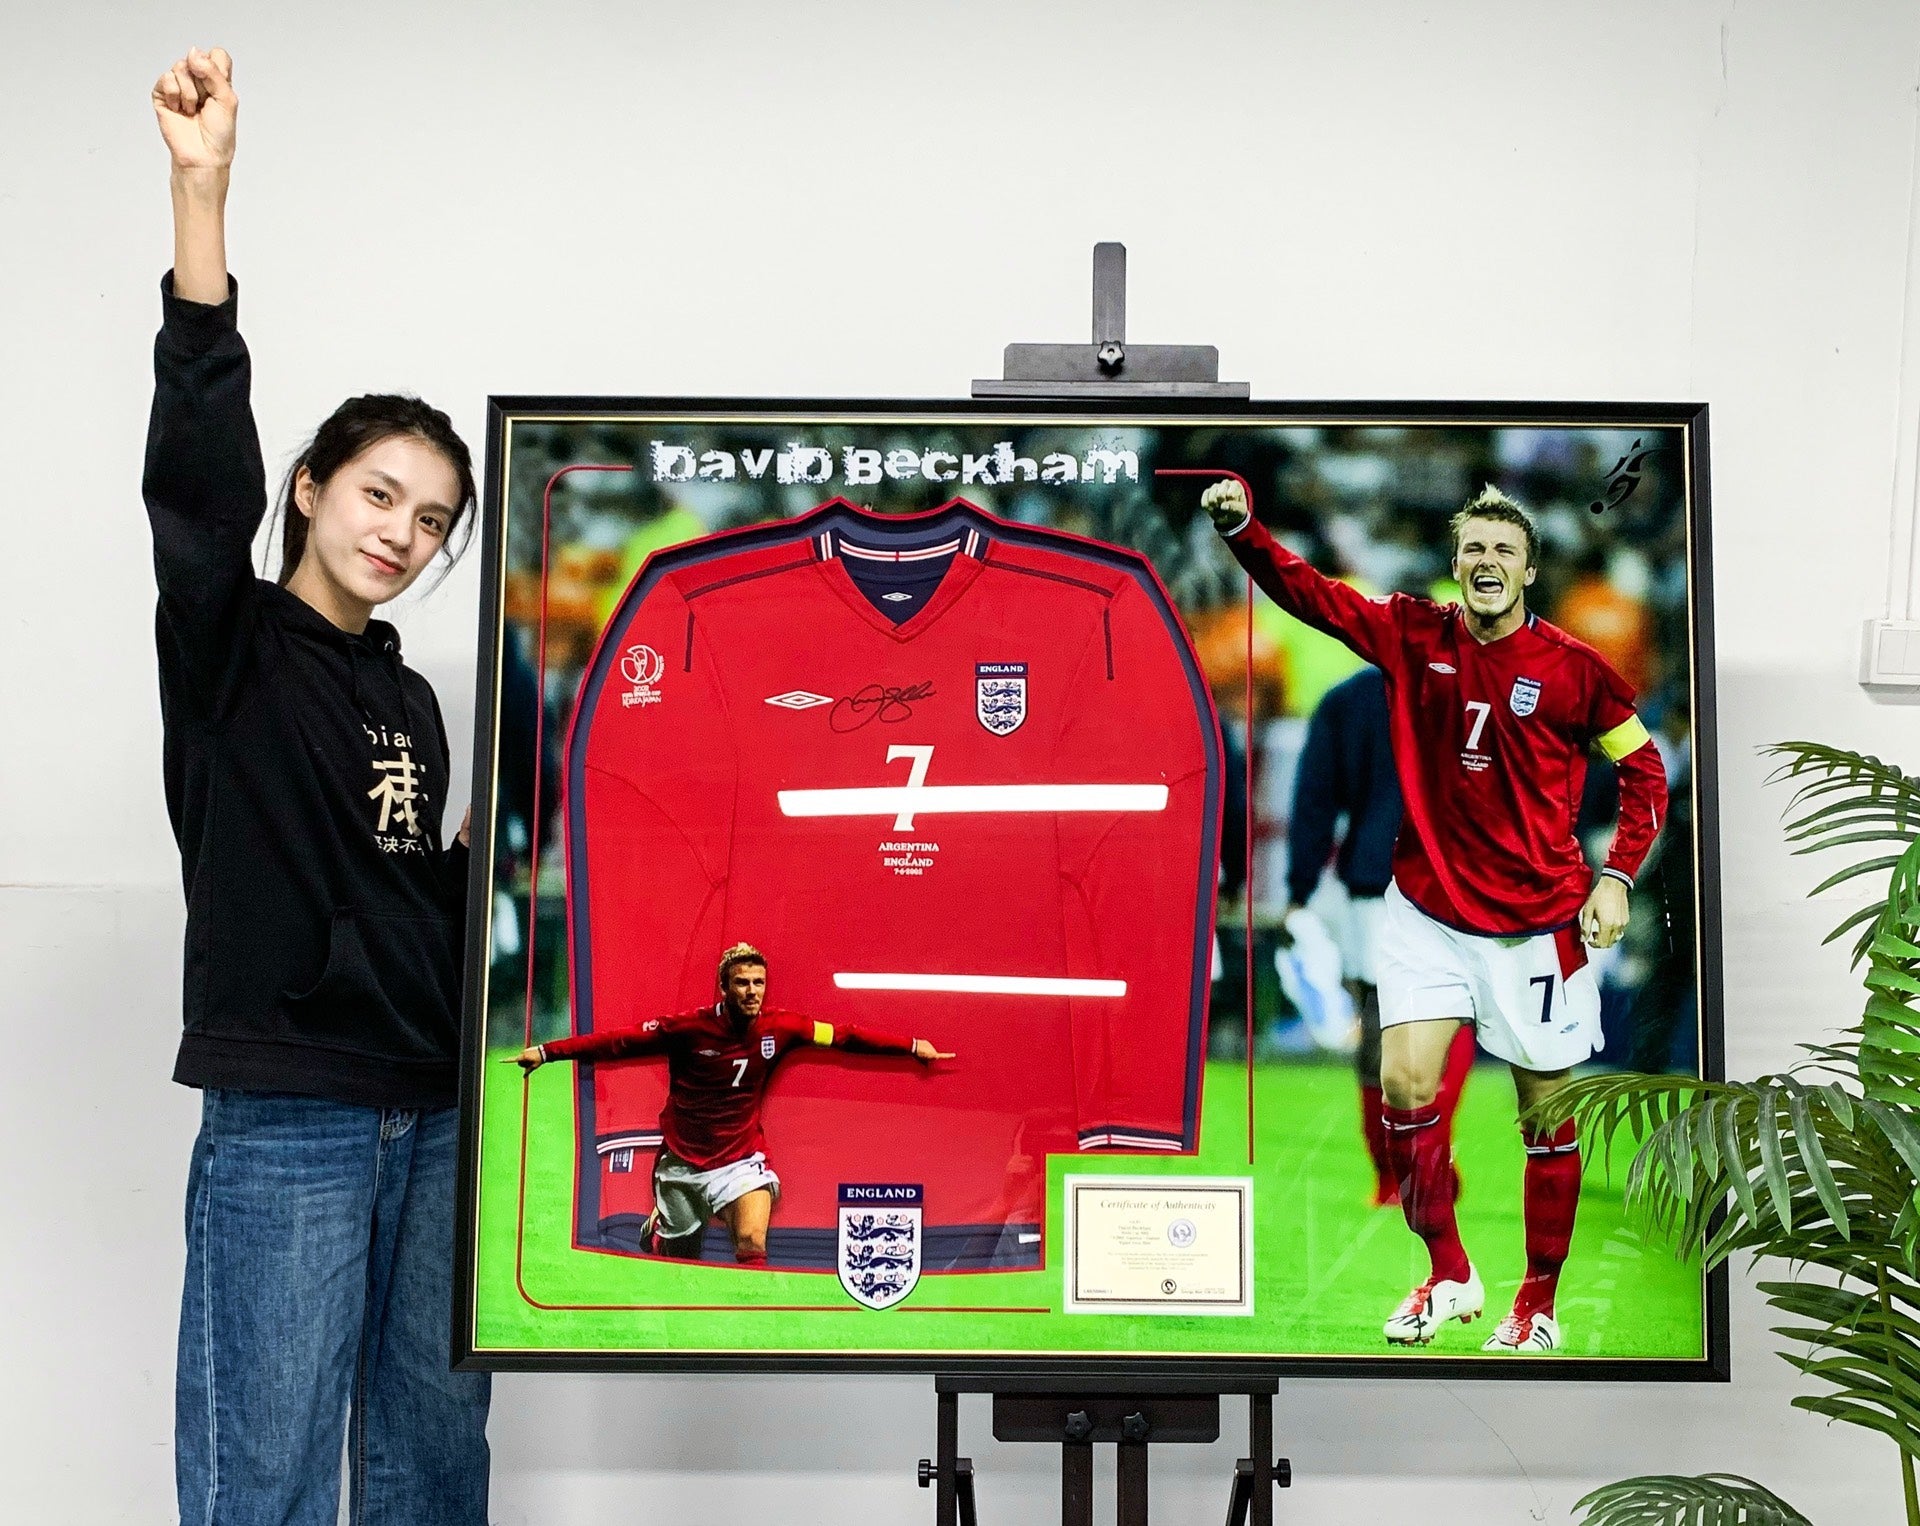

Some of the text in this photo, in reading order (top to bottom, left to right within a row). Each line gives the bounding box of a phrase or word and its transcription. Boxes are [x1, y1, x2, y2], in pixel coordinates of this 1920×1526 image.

[842, 441, 1139, 486] Beckham
[979, 665, 1024, 673] ENGLAND
[1465, 700, 1491, 750] 7
[885, 744, 935, 831] 7
[878, 842, 940, 852] ARGENTINA
[883, 857, 934, 867] ENGLAND
[1529, 974, 1555, 1024] 7
[731, 1058, 749, 1087] 7
[846, 1187, 917, 1199] ENGLAND
[1100, 1199, 1217, 1211] Certificate of Authenticity
